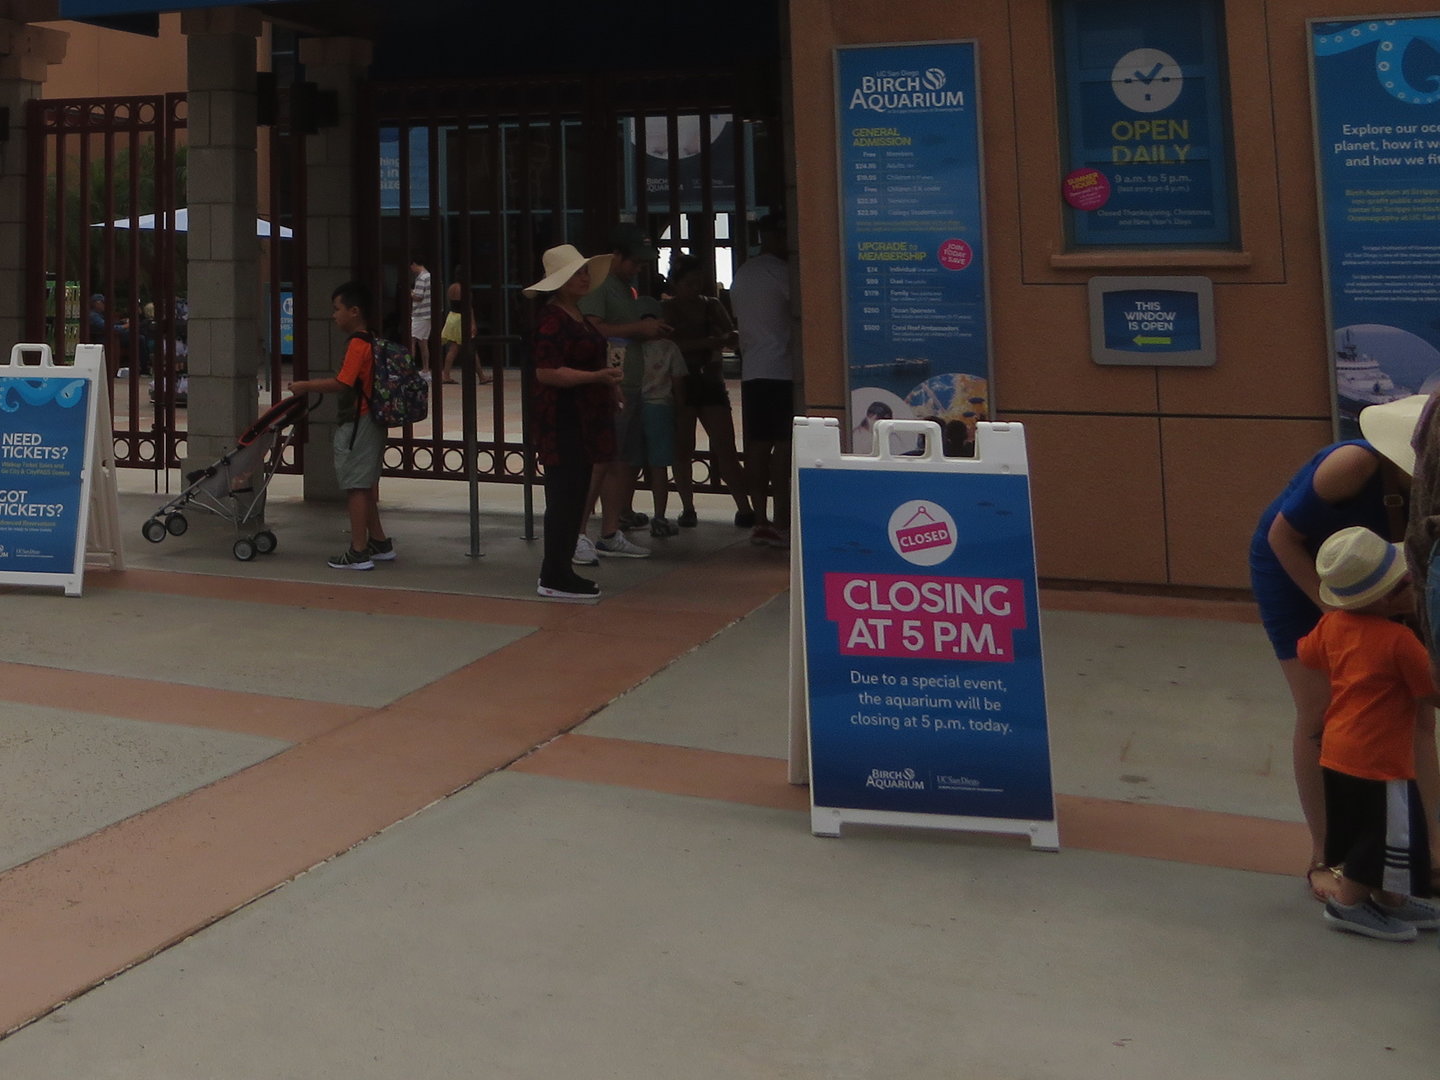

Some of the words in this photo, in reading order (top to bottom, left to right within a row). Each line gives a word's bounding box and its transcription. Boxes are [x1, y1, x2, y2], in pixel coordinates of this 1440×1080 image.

[862, 76, 920, 94] BIRCH
[849, 88, 964, 113] AQUARIUM
[852, 127, 901, 138] GENERAL
[1111, 119, 1189, 141] OPEN
[1342, 124, 1393, 137] Explore
[1395, 124, 1417, 134] our
[852, 136, 913, 147] ADMISSION
[1334, 140, 1380, 154] planet,
[1382, 138, 1412, 150] how
[1414, 137, 1424, 149] it
[1112, 143, 1191, 165] DAILY
[1345, 154, 1370, 167] and
[1372, 154, 1401, 166] how
[1404, 156, 1425, 166] we
[1114, 174, 1121, 183] 9
[1123, 175, 1146, 183] a.m.
[1147, 174, 1159, 183] to
[1160, 173, 1168, 183] 5
[1168, 175, 1192, 186] p.m.
[857, 241, 907, 252] UPGRADE
[857, 251, 929, 262] MEMBERSHIP
[1135, 301, 1161, 311] THIS
[1124, 311, 1177, 321] WINDOW
[1128, 321, 1139, 331] IS
[1141, 321, 1174, 331] OPEN
[2, 432, 42, 446] NEED
[1, 445, 69, 461] TICKETS?
[900, 528, 949, 548] CLOSED
[843, 578, 1012, 617] CLOSING
[846, 617, 893, 650] AT
[901, 619, 925, 651] 5
[933, 620, 1004, 655] P.M.
[850, 670, 879, 685] Due
[882, 673, 897, 686] to
[899, 676, 908, 686] a
[911, 675, 961, 690] special
[963, 678, 1008, 693] event,
[858, 692, 881, 705] the
[885, 694, 952, 710] aquarium
[955, 696, 981, 711] will
[983, 697, 1002, 711] be
[850, 712, 900, 730] closing
[903, 716, 918, 728] at
[921, 714, 931, 728] 5
[934, 719, 965, 732] p.m.
[968, 718, 1013, 735] today.
[871, 768, 903, 780] BIRCH
[865, 775, 925, 790] AQUARIUM
